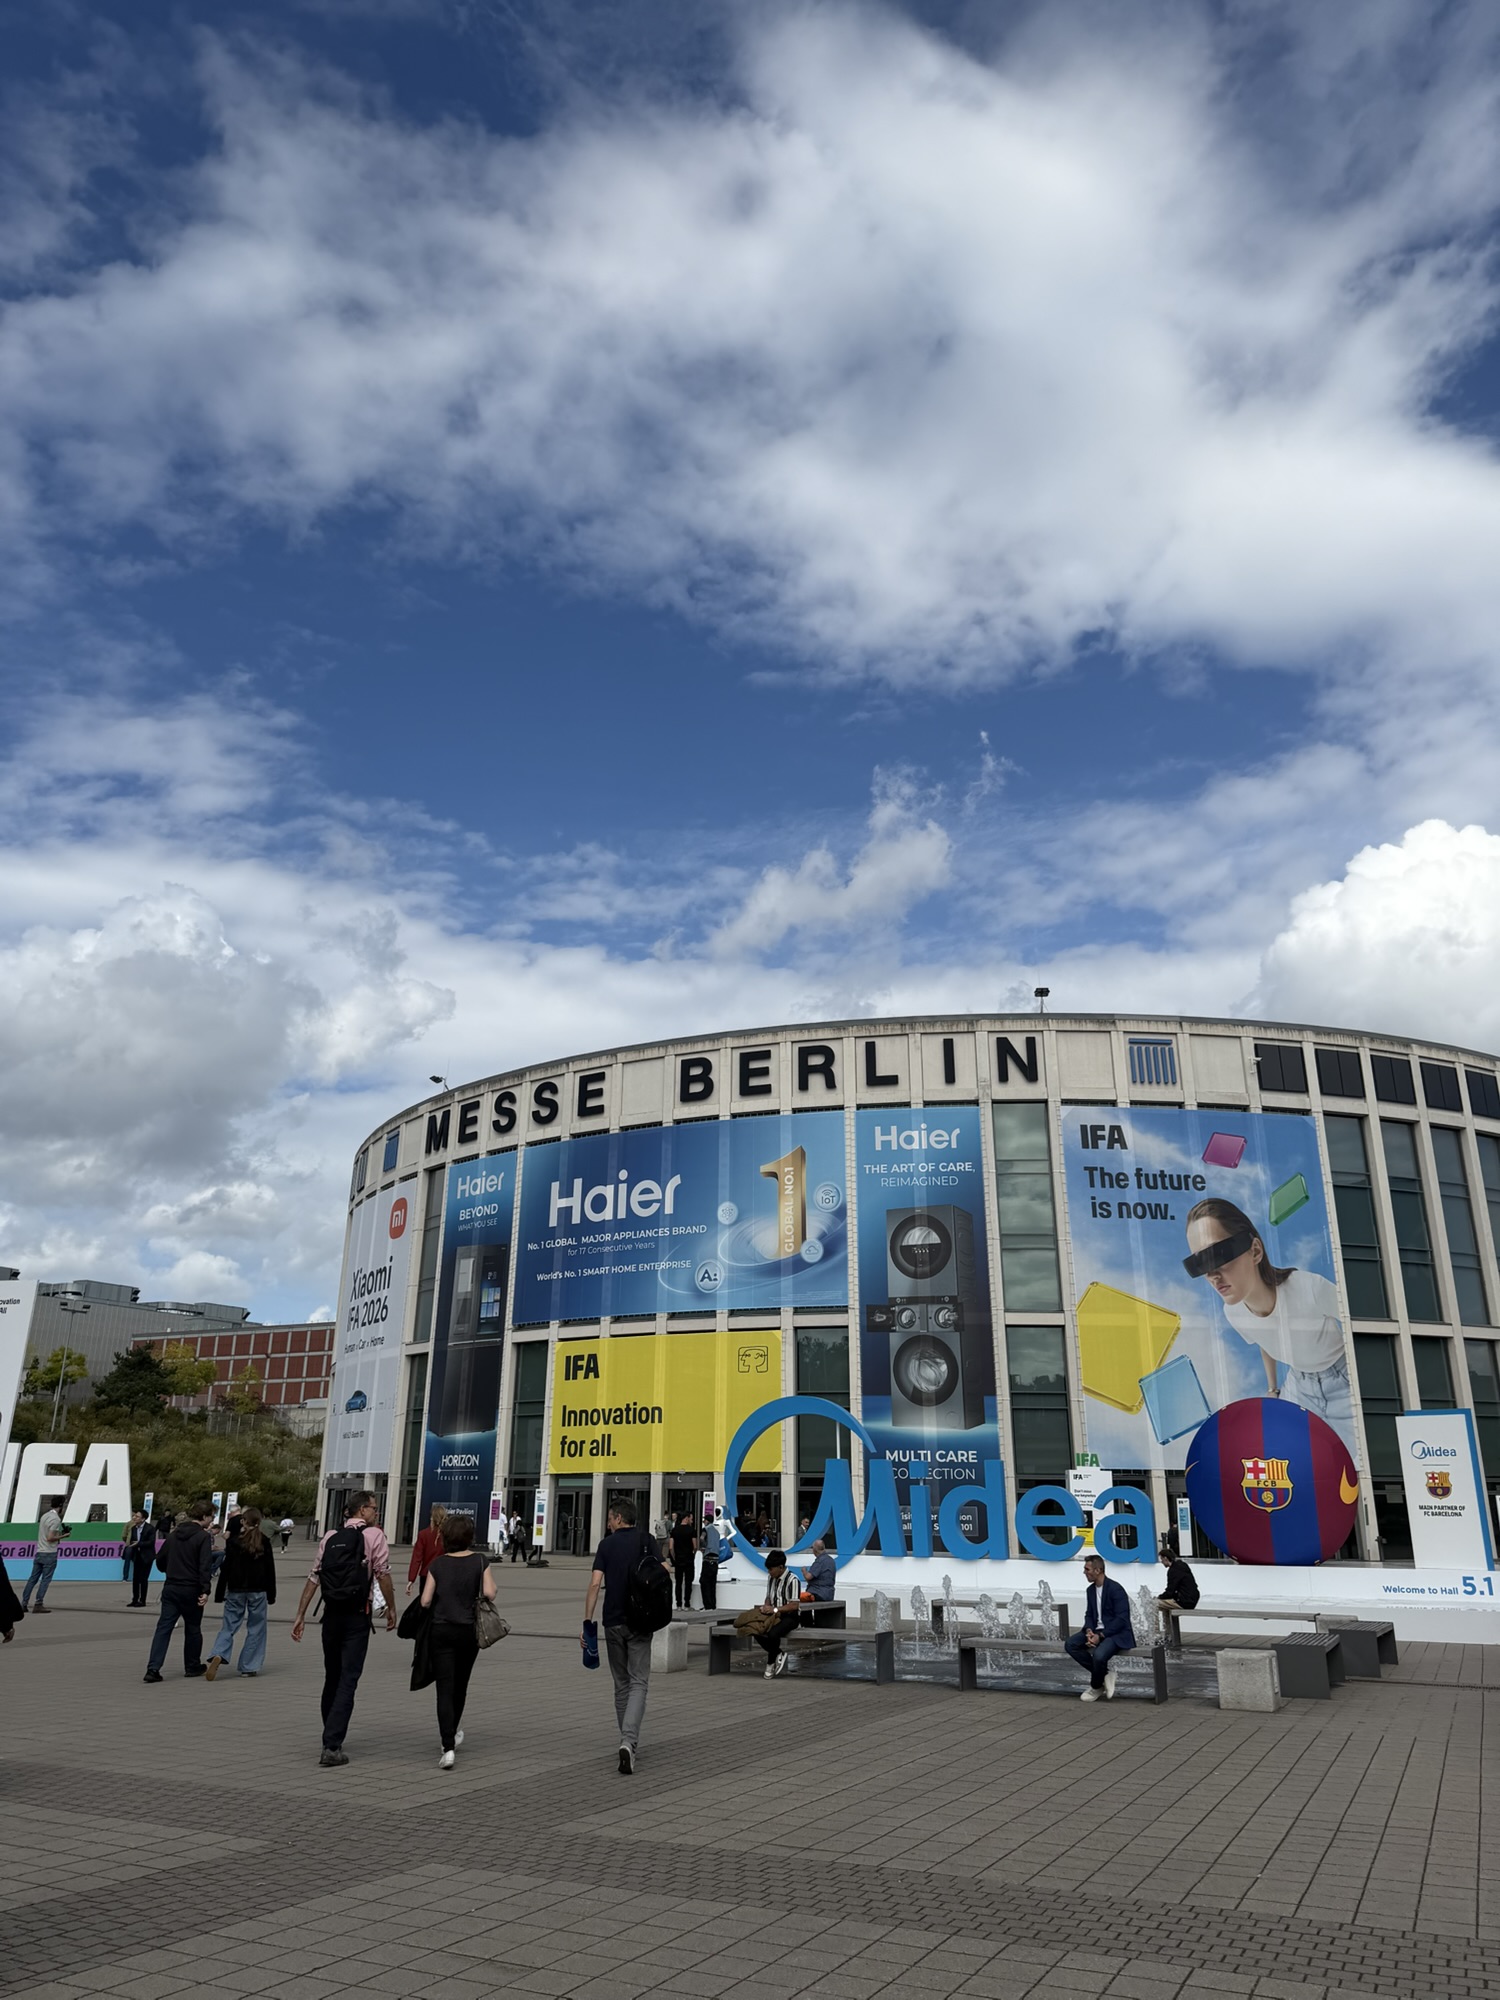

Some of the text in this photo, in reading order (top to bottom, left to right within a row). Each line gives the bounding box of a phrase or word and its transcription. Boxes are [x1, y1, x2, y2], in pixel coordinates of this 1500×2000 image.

[425, 1036, 1039, 1154] MESSE BERLIN
[874, 1122, 961, 1151] Haier
[1080, 1124, 1128, 1150] IFA
[863, 1161, 976, 1174] THE ART OF CARE,
[1083, 1166, 1207, 1191] The future
[456, 1170, 505, 1199] Haier
[881, 1175, 959, 1187] REIMAGINED
[549, 1169, 682, 1228] Haier
[784, 1166, 795, 1253] GLOBAL NO.1
[821, 1195, 836, 1205] IoT
[1090, 1195, 1175, 1220] is now.
[459, 1203, 499, 1221] BEYOND
[457, 1218, 498, 1232] WHAT YOU SEE
[527, 1242, 540, 1251] No.
[545, 1237, 578, 1249] GLOBAL
[581, 1233, 612, 1244] MAJOR
[612, 1227, 670, 1241] APPLIANCES
[672, 1224, 707, 1236] BRAND
[567, 1240, 656, 1257] for 17 Consecutive Years
[349, 1255, 393, 1303] Xiaomi
[537, 1271, 563, 1281] World's
[564, 1269, 577, 1278] No.
[583, 1266, 610, 1277] SMART
[611, 1264, 637, 1274] HOME
[638, 1260, 692, 1272] ENTERPRISE
[361, 1295, 389, 1328] 2026
[564, 1353, 600, 1381] IFA
[561, 1401, 663, 1428] Innovation
[560, 1433, 617, 1458] for all.
[885, 1449, 978, 1463] MULTI CARE
[1411, 1440, 1457, 1460] Midea
[441, 1454, 480, 1467] HORIZON
[1075, 1452, 1100, 1467] IFA
[0, 1442, 133, 1524] IFA
[724, 1395, 1158, 1581] Midea
[18, 1544, 35, 1558] all
[1382, 1575, 1494, 1596] Welcome to Hall 5.1
